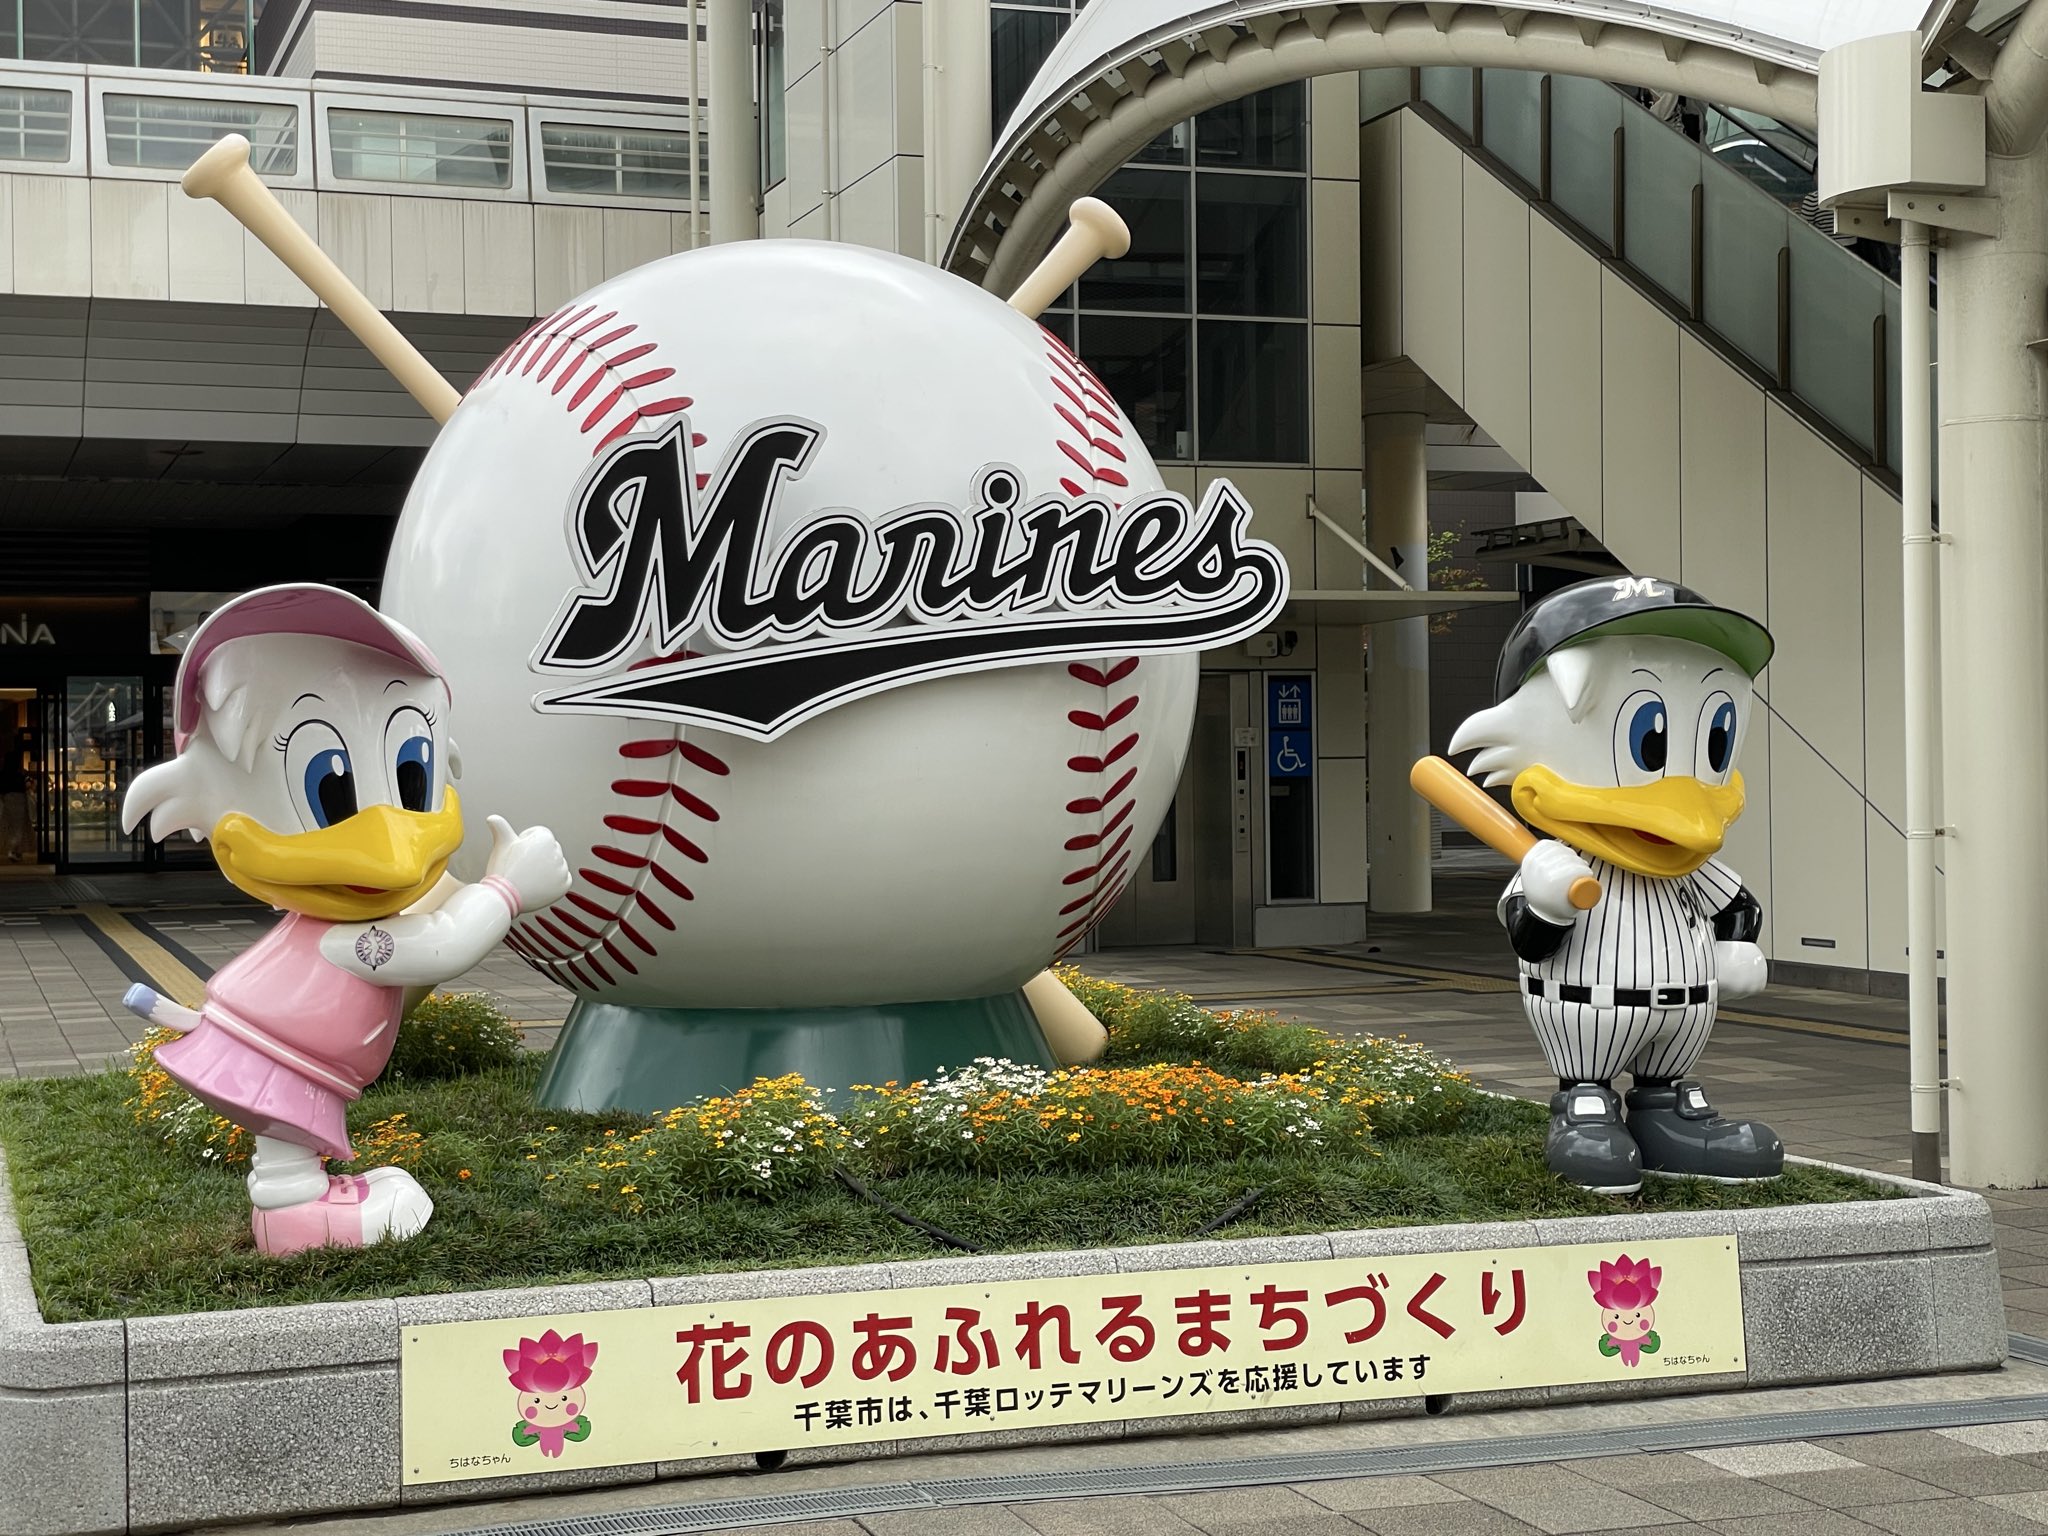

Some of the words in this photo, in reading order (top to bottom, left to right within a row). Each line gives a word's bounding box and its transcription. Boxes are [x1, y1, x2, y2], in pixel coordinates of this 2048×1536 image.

[530, 413, 1290, 676] Marines
[1612, 576, 1666, 602] M
[676, 1268, 1527, 1404] 花のあふれるまちづくり
[1663, 1354, 1710, 1366] ちはなちゃん
[794, 1354, 1431, 1432] 千葉市は、千葉ロッテマリーンズを応援しています
[449, 1453, 511, 1468] ちはなちゃん
